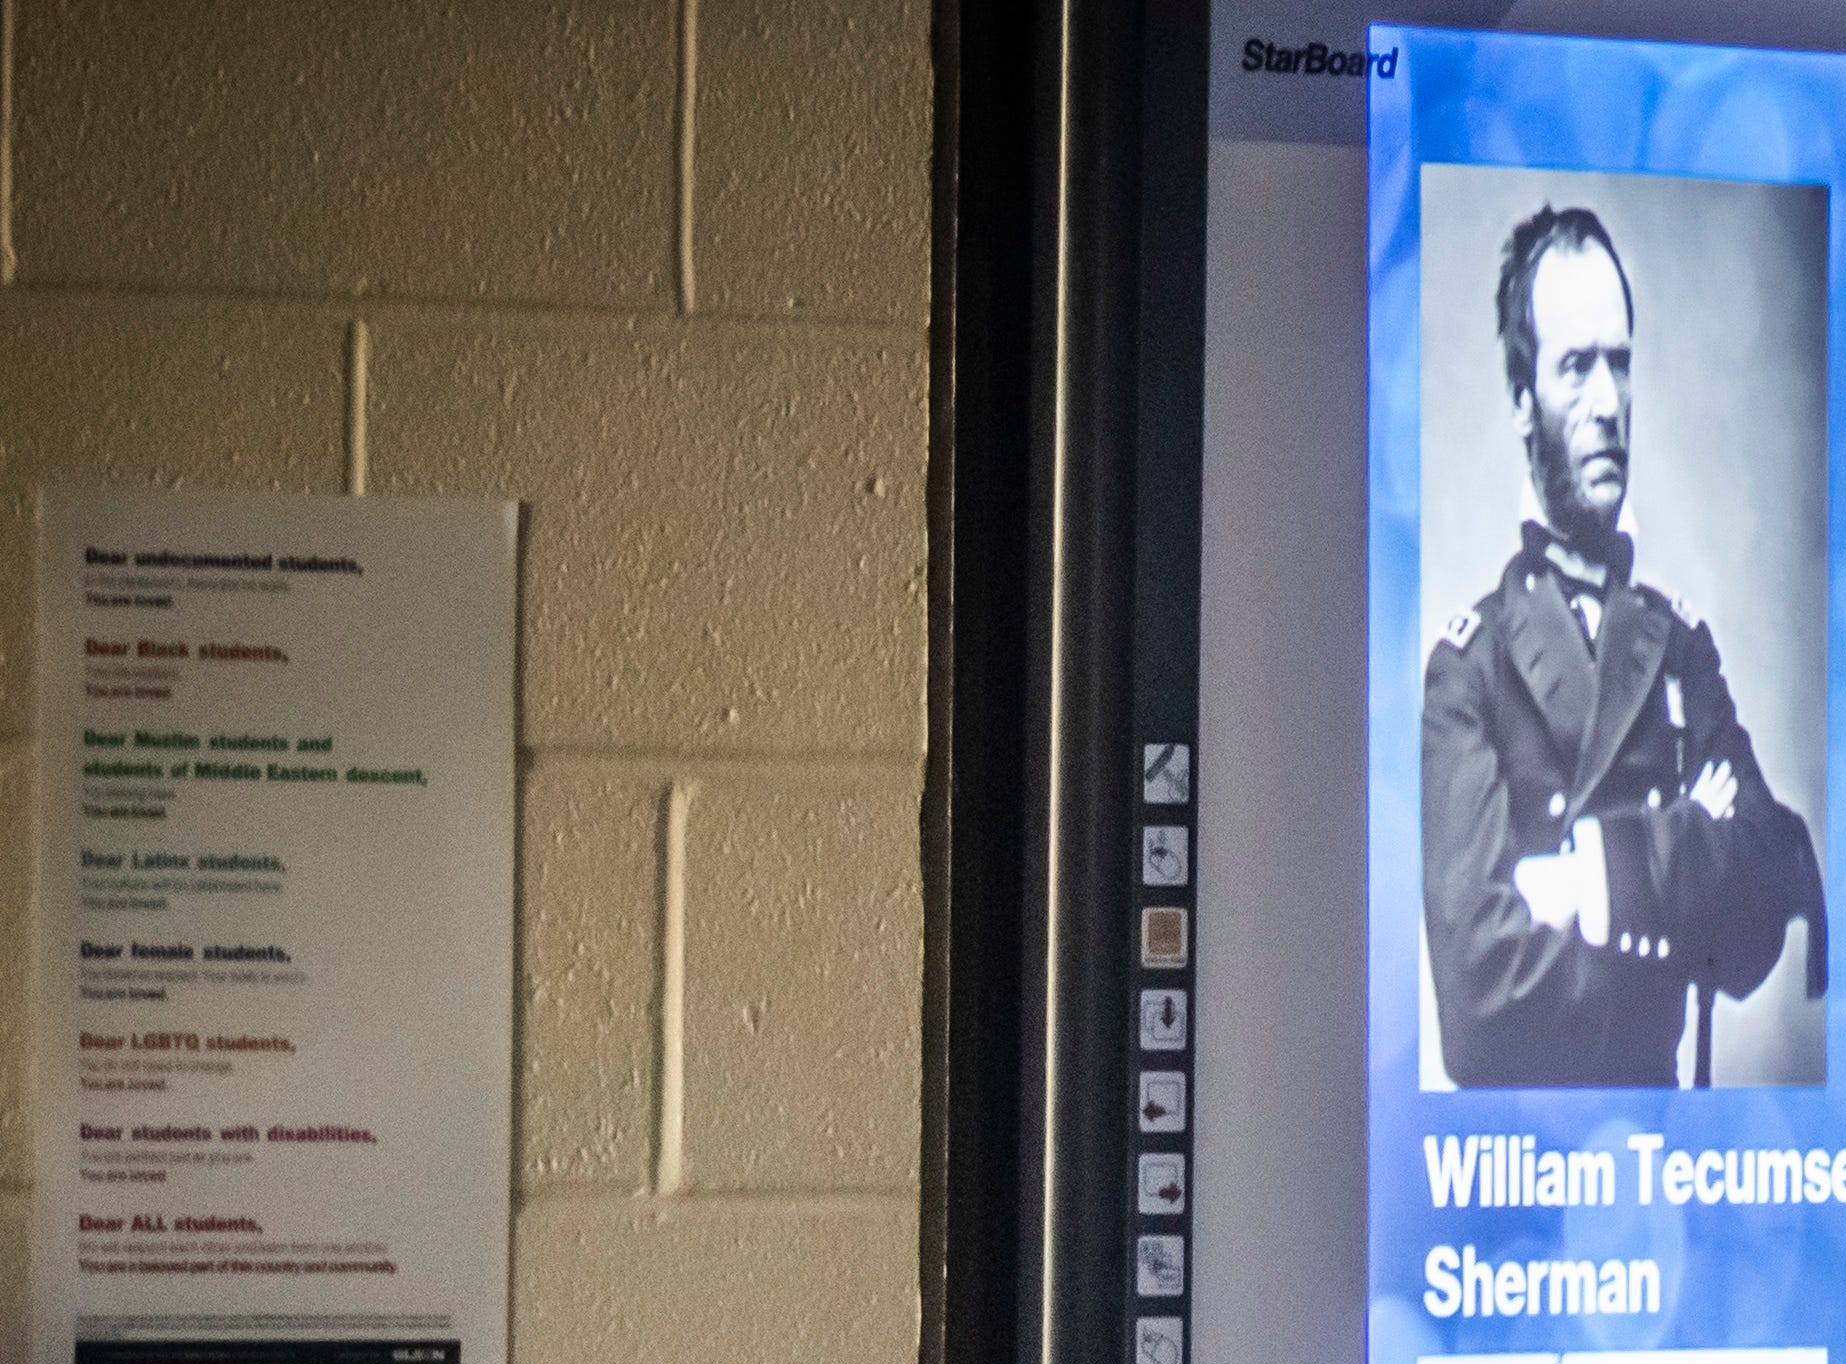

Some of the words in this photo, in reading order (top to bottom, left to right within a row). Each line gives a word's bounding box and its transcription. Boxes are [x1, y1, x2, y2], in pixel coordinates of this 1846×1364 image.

[1241, 37, 1398, 80] StarBoard
[85, 547, 127, 566] Dear
[135, 551, 272, 571] undocumented
[278, 555, 363, 576] students,
[85, 638, 128, 658] Dear
[137, 639, 189, 659] Black
[198, 642, 289, 665] students,
[84, 729, 125, 749] Dear
[133, 730, 200, 750] Muslim
[209, 733, 289, 752] students
[297, 735, 333, 752] and
[84, 761, 163, 779] students
[170, 762, 189, 779] of
[194, 762, 262, 781] Middle
[267, 763, 338, 782] Eastern
[345, 767, 428, 787] descent,
[81, 849, 123, 870] Dear
[197, 853, 286, 875] students,
[80, 939, 123, 960] Dear
[131, 941, 195, 961] female
[203, 944, 292, 964] students,
[79, 1030, 125, 1051] Dear
[131, 1030, 200, 1052] LGBTQ
[206, 1033, 297, 1056] students,
[80, 1121, 123, 1142] Dear
[131, 1124, 212, 1142] students
[220, 1124, 260, 1142] with
[267, 1123, 378, 1145] disabilities,
[1423, 1134, 1615, 1208] William
[79, 1212, 125, 1233] Dear
[131, 1213, 168, 1234] ALL
[174, 1216, 264, 1236] students,
[1423, 1243, 1660, 1317] Sherman
